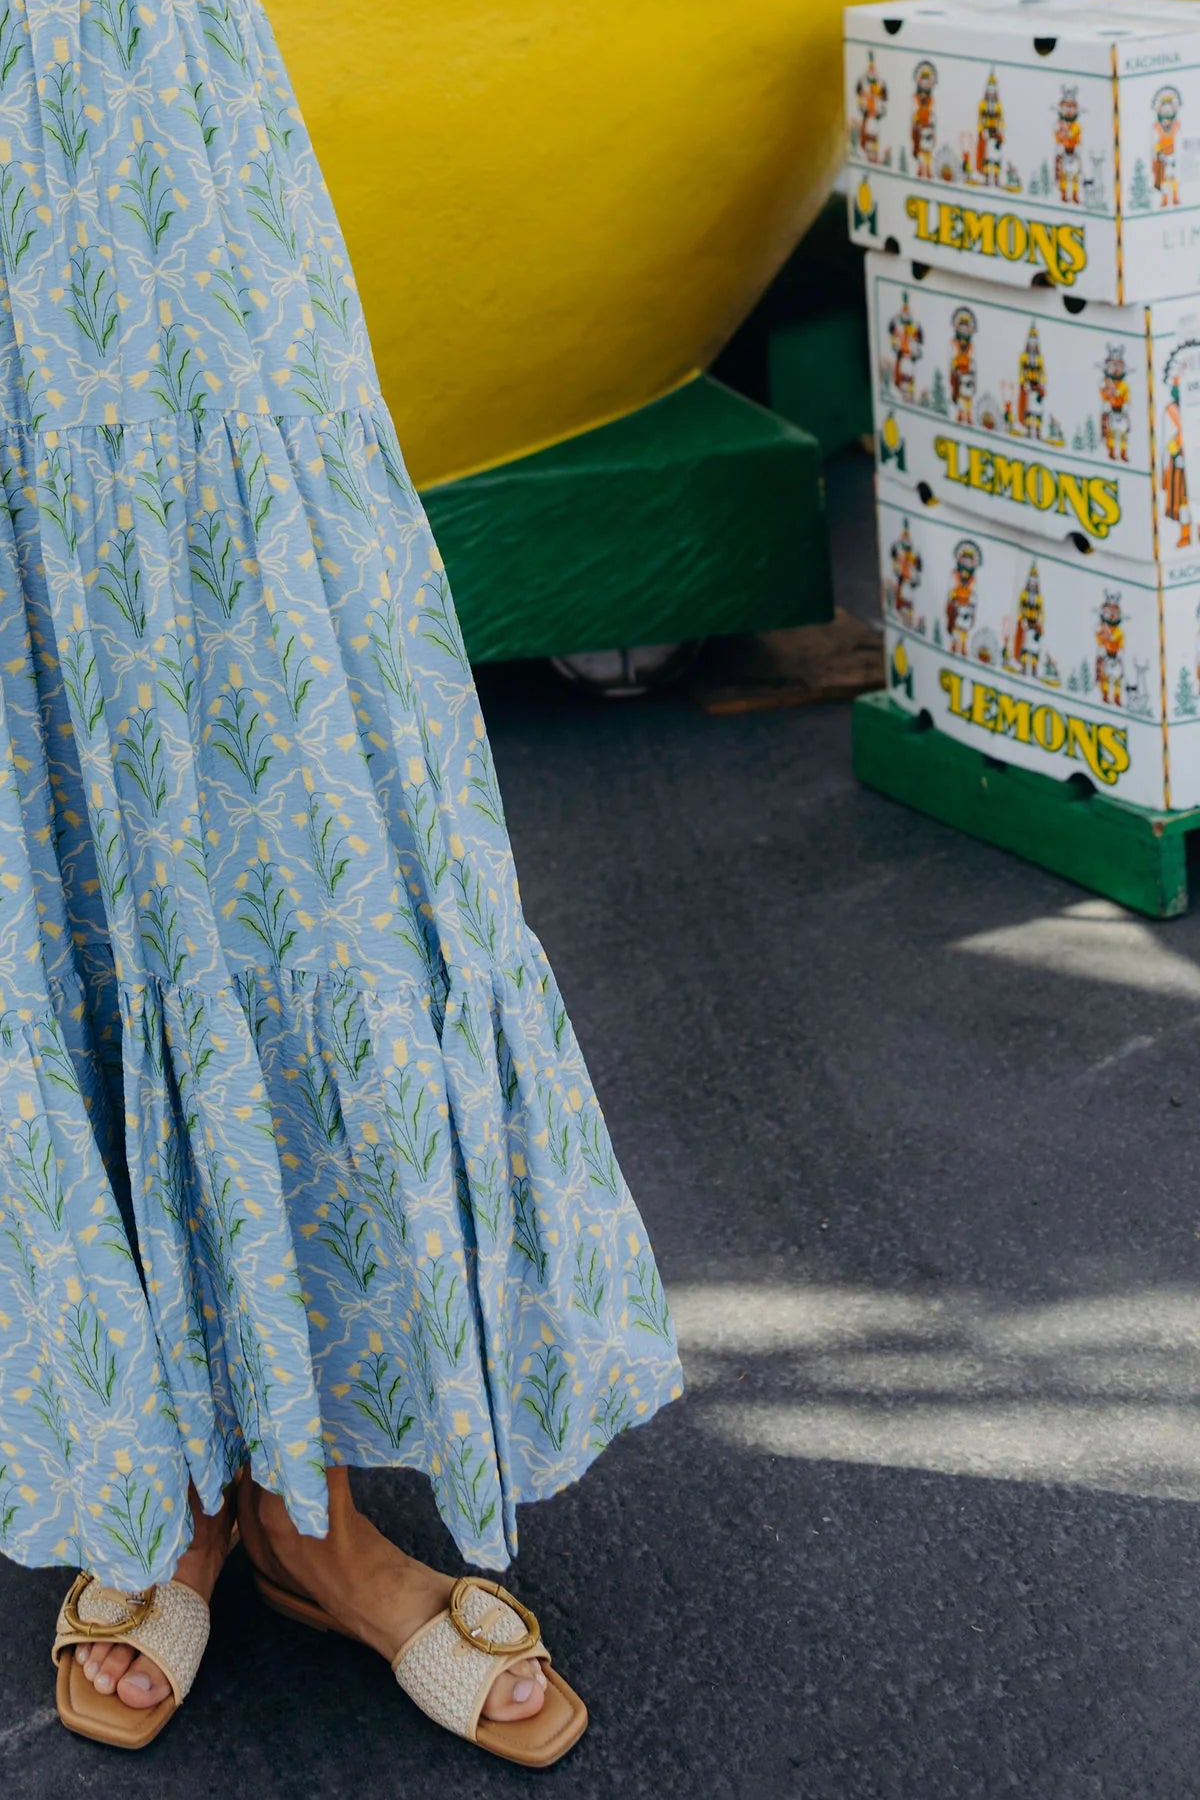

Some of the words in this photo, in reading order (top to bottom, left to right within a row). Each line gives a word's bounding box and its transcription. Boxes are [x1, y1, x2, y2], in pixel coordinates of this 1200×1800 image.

[905, 195, 1087, 286] LEMONS
[934, 434, 1122, 539] LEMONS
[938, 667, 1131, 786] LEMONS
